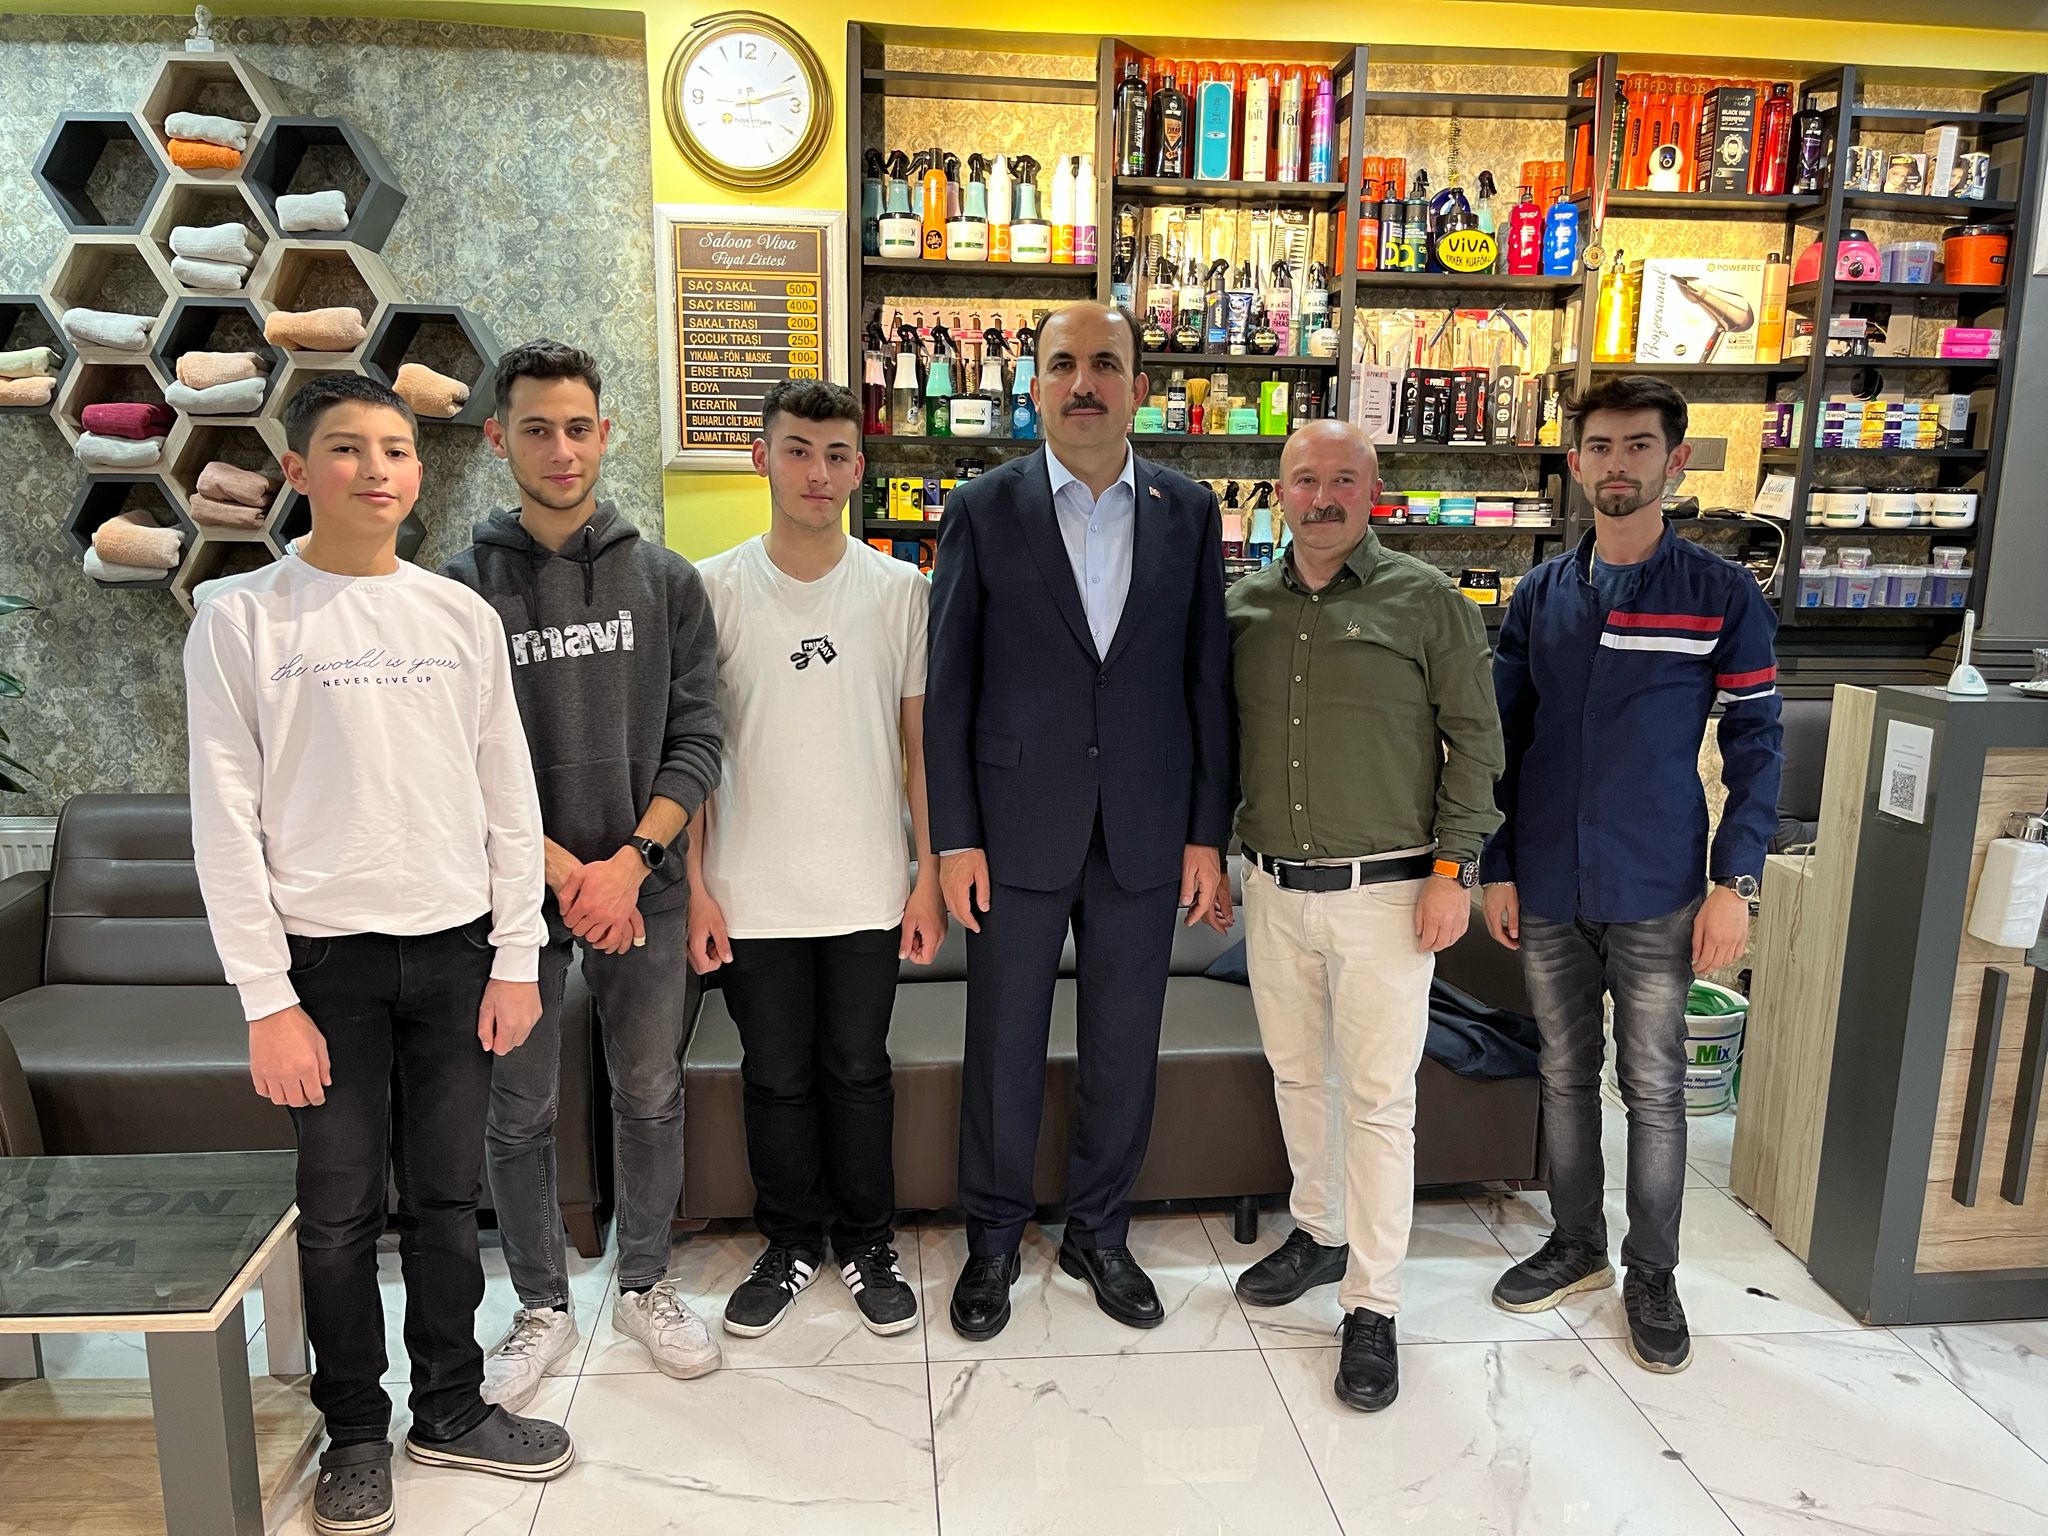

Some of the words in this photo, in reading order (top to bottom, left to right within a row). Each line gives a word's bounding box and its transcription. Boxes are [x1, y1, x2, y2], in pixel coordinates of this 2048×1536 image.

[738, 41, 757, 60] 12
[692, 88, 704, 105] 9
[789, 97, 801, 114] 3
[1282, 110, 1299, 126] taf
[699, 231, 753, 249] Saloon
[757, 233, 798, 250] Viva
[711, 251, 745, 269] Fiyat
[746, 252, 787, 267] Listesi
[1717, 264, 1761, 272] POWERTEC
[688, 280, 714, 294] SAÇ
[715, 281, 757, 292] SAKAL
[688, 299, 714, 312] SAÇ
[689, 317, 725, 329] SAKAL
[689, 333, 729, 346] ÇOCUK
[730, 334, 762, 347] TRAŞI
[689, 350, 720, 362] YIKAMA
[724, 350, 740, 362] FÖN
[745, 352, 772, 363] MASKE
[690, 366, 719, 377] ENSE
[720, 367, 752, 380] TRAŞI
[691, 382, 720, 393] BOYA
[692, 415, 725, 426] BUHARLI
[693, 431, 722, 442] DAMAT
[724, 432, 750, 444] TRAŞI
[511, 609, 634, 667] mavi
[271, 653, 308, 681] the
[313, 648, 386, 674] world
[386, 658, 406, 668] is
[323, 676, 370, 687] NEVER
[376, 676, 408, 685] GIVE
[1695, 1044, 1731, 1065] Mix
